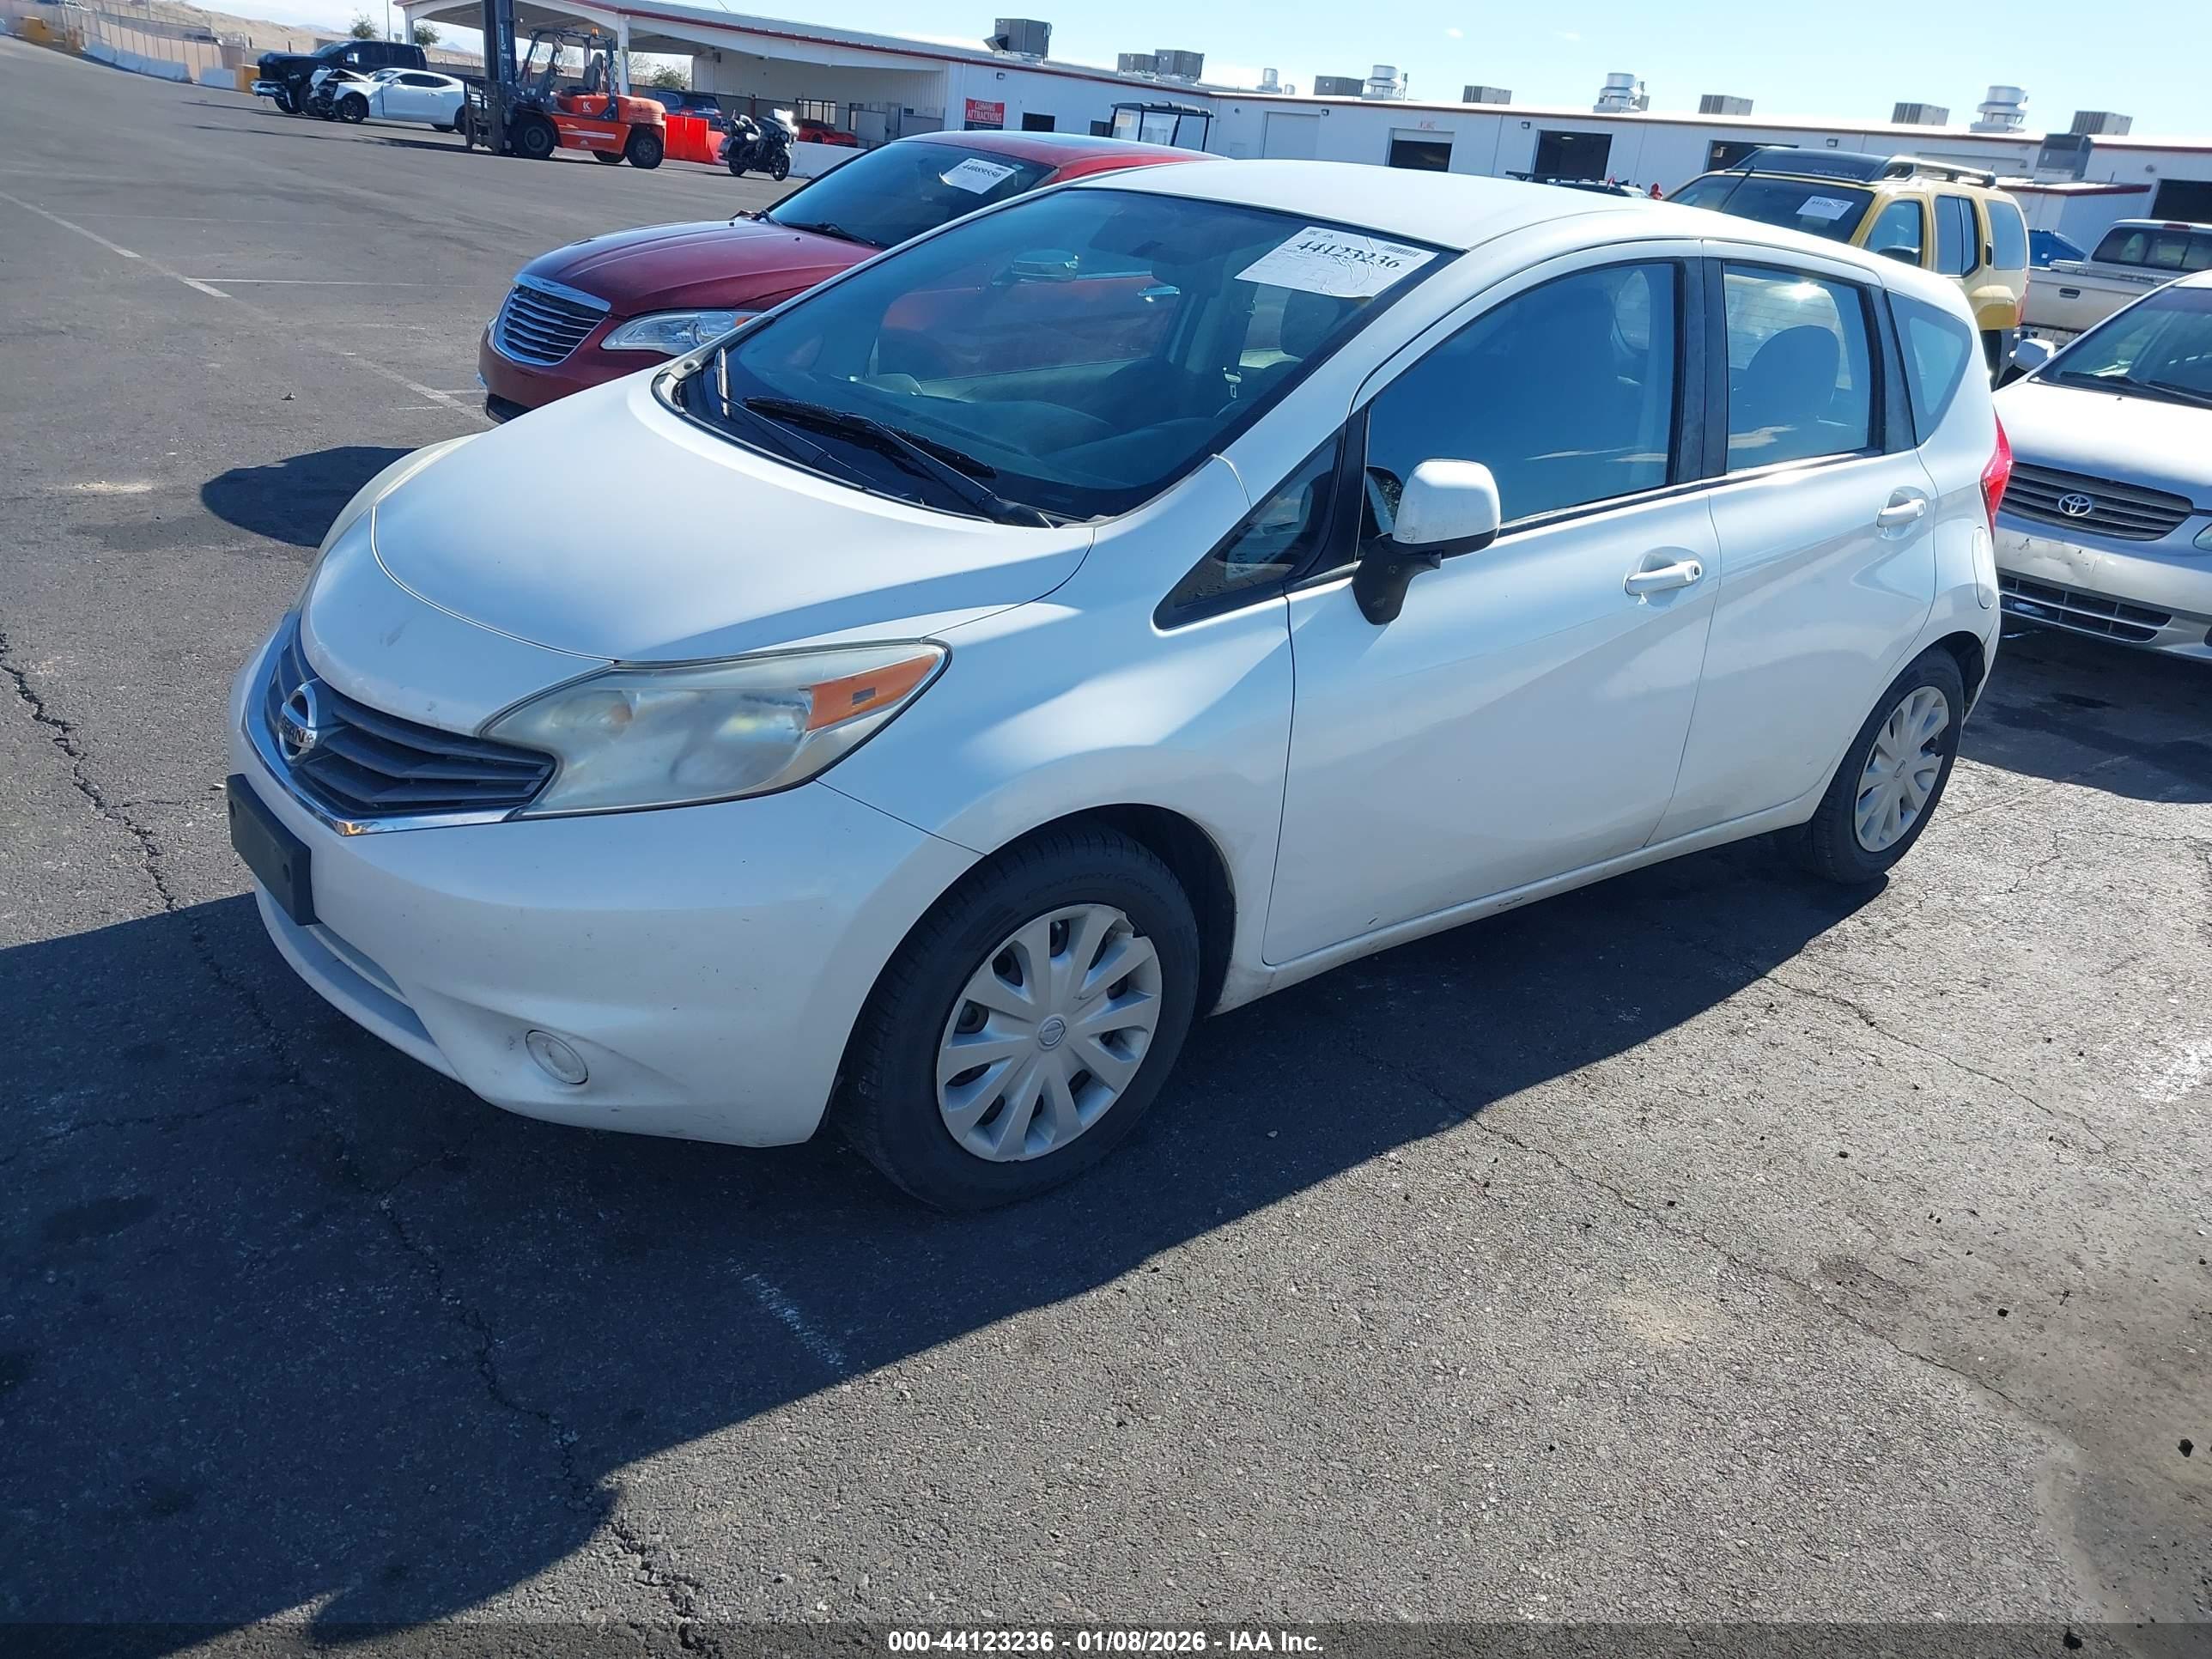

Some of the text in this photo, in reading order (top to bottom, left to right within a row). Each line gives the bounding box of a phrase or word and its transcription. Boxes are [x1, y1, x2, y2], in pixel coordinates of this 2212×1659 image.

[975, 101, 996, 112] COMING
[966, 109, 1003, 122] ATTRACTIONS
[1812, 168, 1860, 179] NISSAN
[1297, 240, 1406, 270] 44123236
